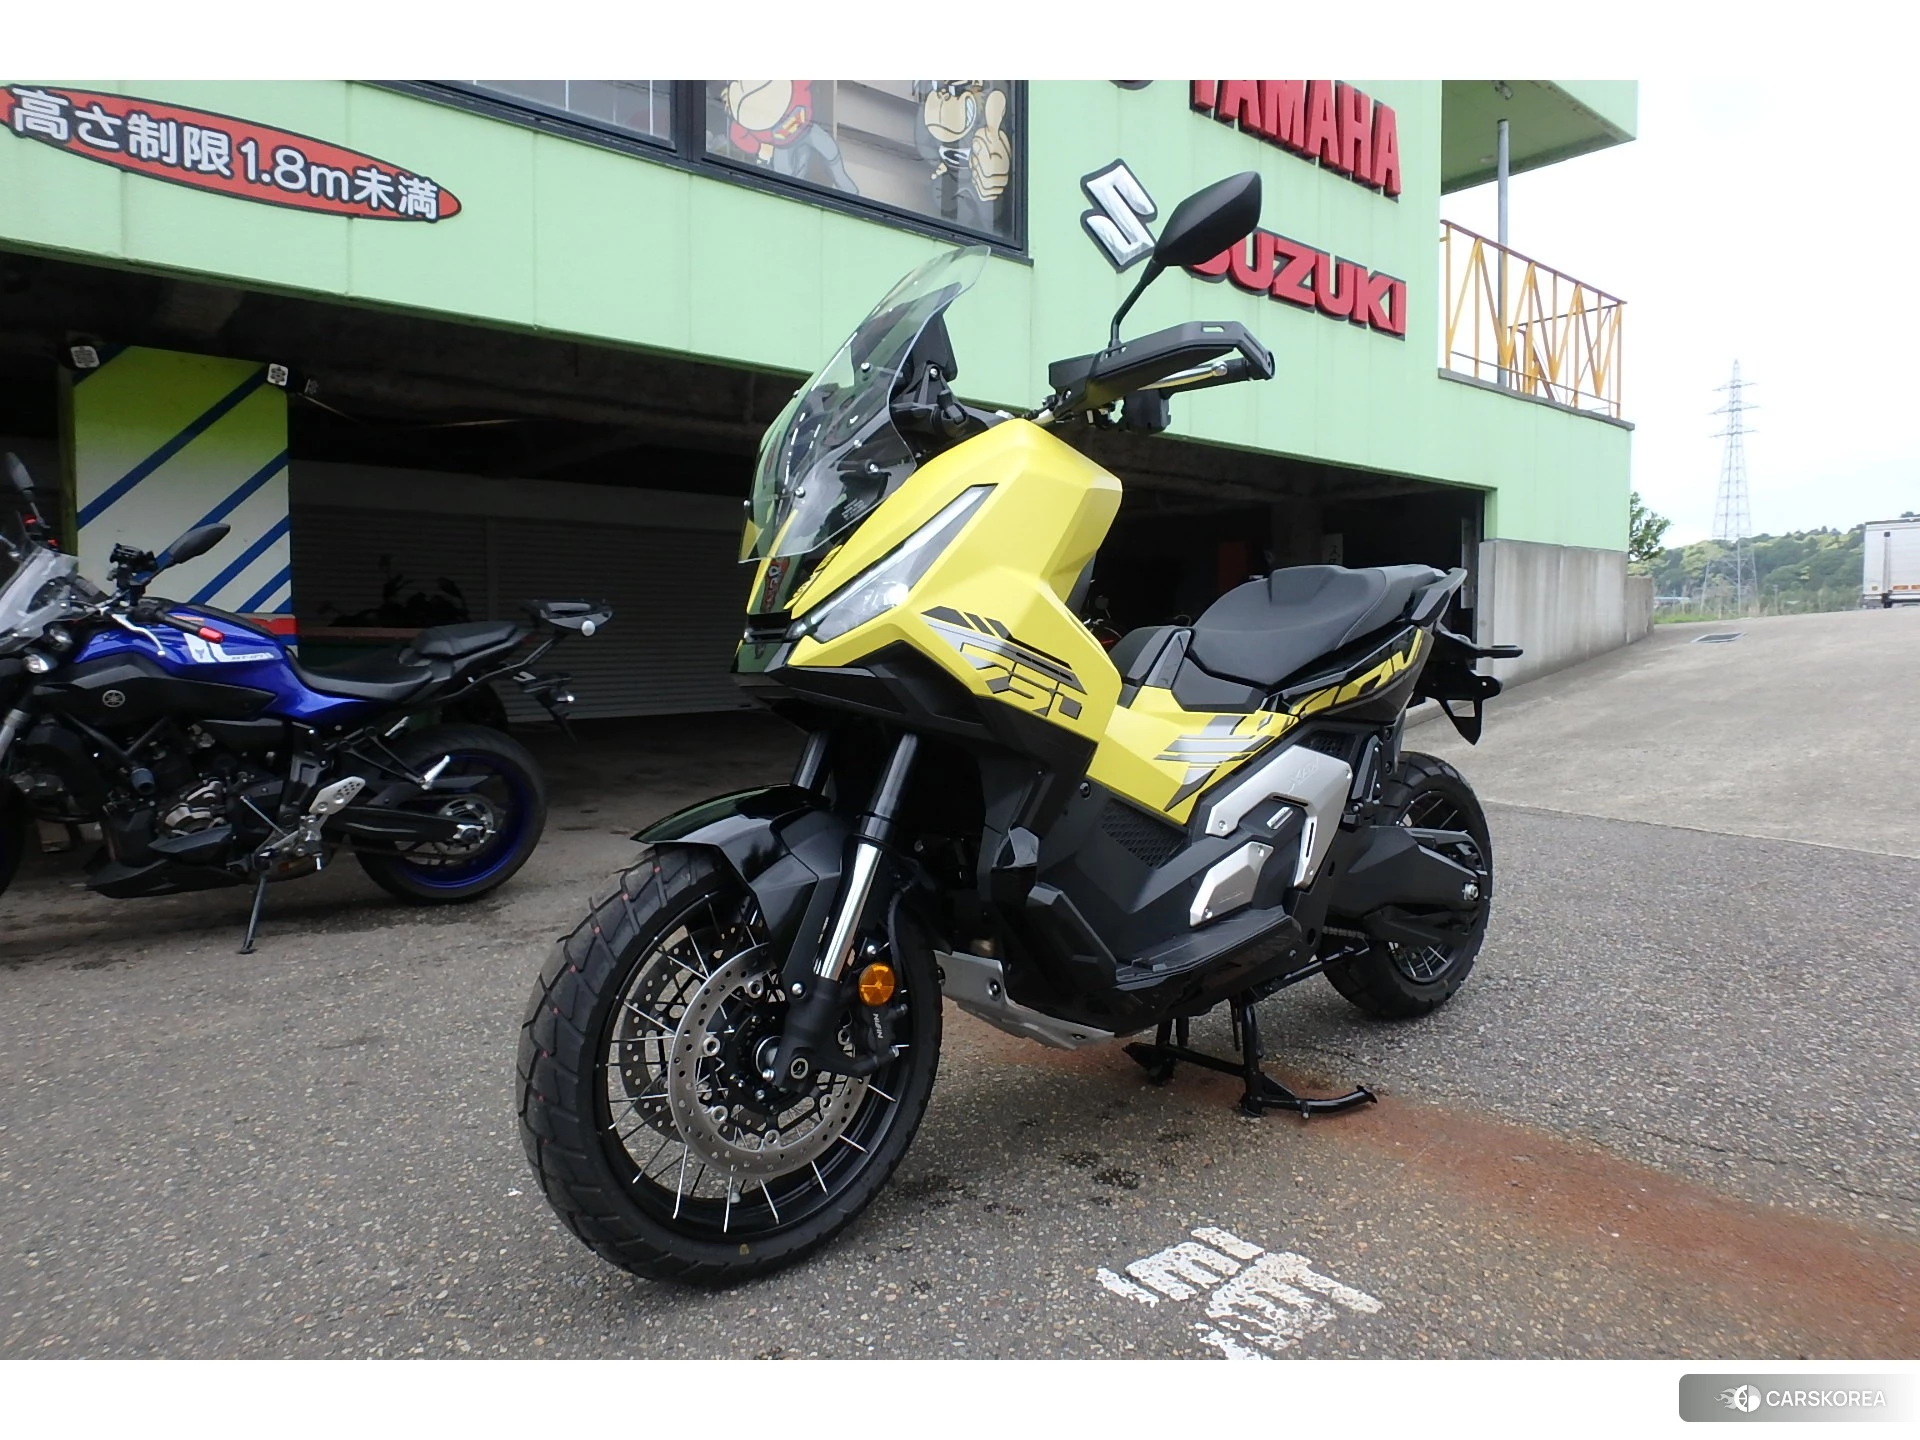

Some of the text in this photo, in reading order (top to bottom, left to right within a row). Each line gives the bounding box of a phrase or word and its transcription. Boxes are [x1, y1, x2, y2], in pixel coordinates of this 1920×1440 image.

[13, 86, 438, 220] 高さ制限1.8m未満
